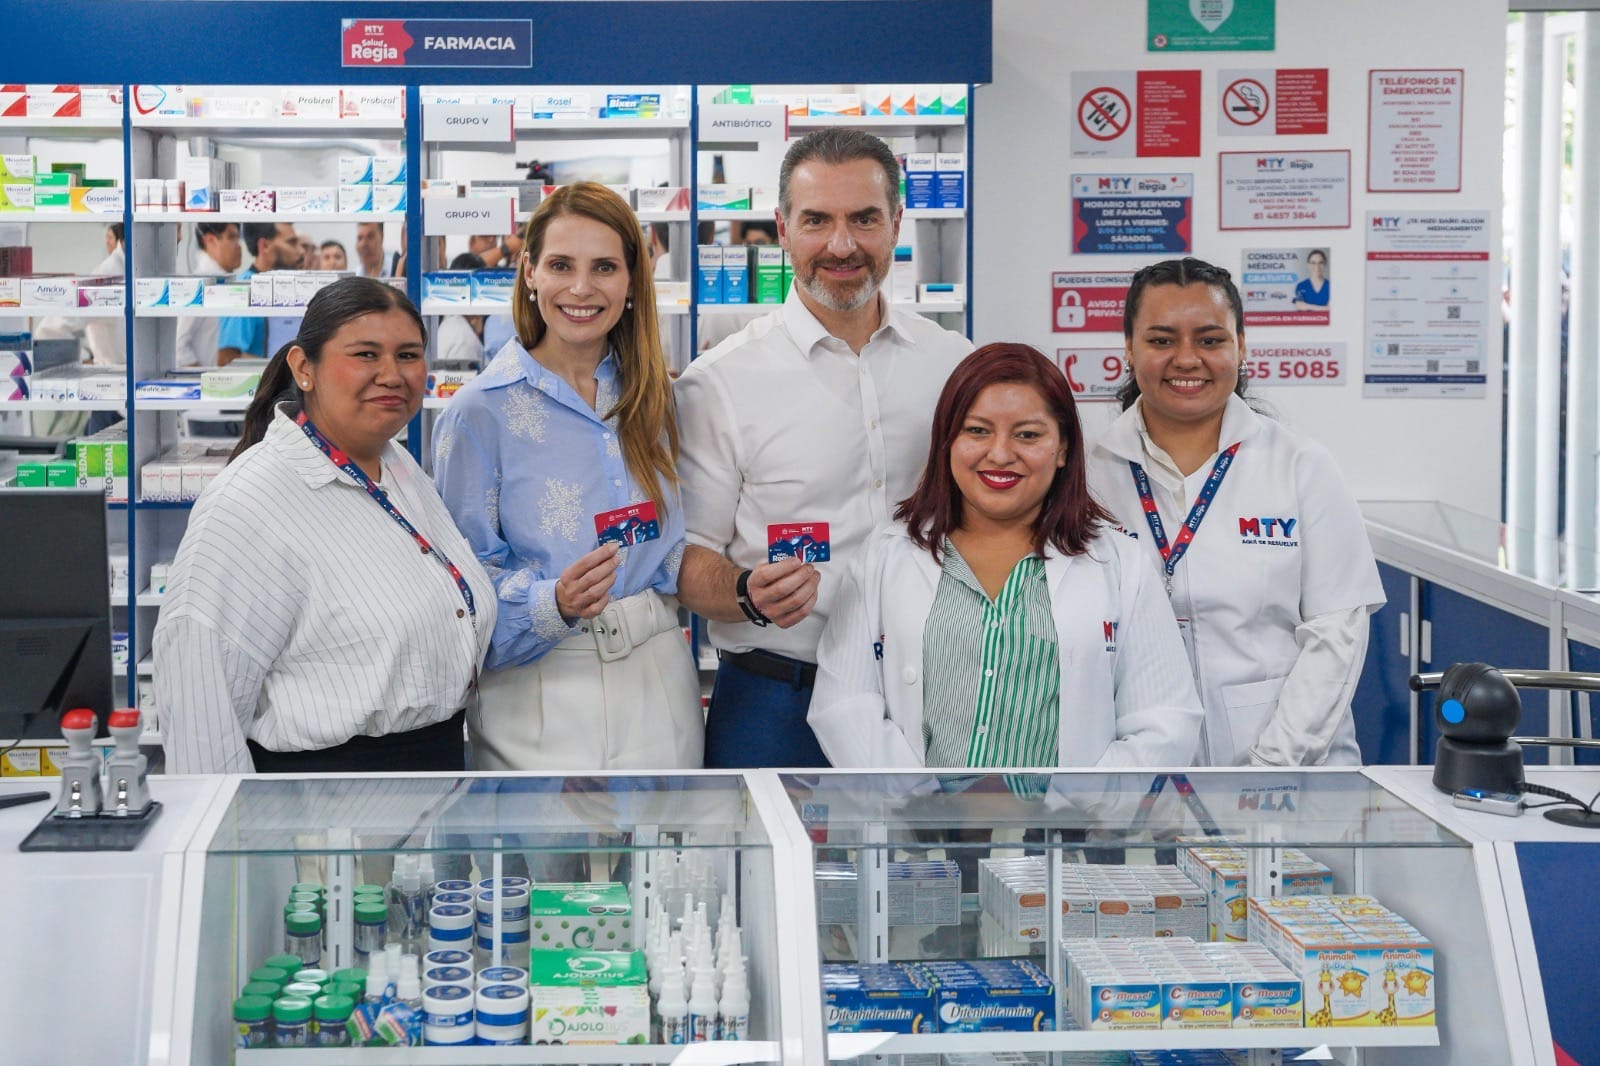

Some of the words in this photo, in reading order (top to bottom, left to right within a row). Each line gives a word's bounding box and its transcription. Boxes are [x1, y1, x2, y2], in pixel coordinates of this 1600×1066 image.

[364, 25, 384, 33] MTY
[424, 36, 516, 50] FARMACIA
[351, 44, 398, 62] Regia
[1378, 76, 1440, 85] TELÉFONOS
[446, 117, 480, 125] GRUPO
[712, 118, 772, 128] ANTIBIÓTICO
[1256, 158, 1284, 168] MTY
[1098, 178, 1132, 189] MTY
[1373, 217, 1401, 227] MTY
[1250, 348, 1332, 357] SUGERENCIAS
[1103, 356, 1122, 381] 9
[1278, 361, 1339, 379] 5085
[105, 444, 114, 498] NEOSEDAL
[1239, 518, 1296, 538] MTY
[873, 642, 883, 660] R
[1318, 952, 1356, 961] Animalin
[1382, 952, 1421, 960] Animalin
[829, 1006, 913, 1020] Difenhidramina
[950, 1004, 1034, 1018] Difenhidramina
